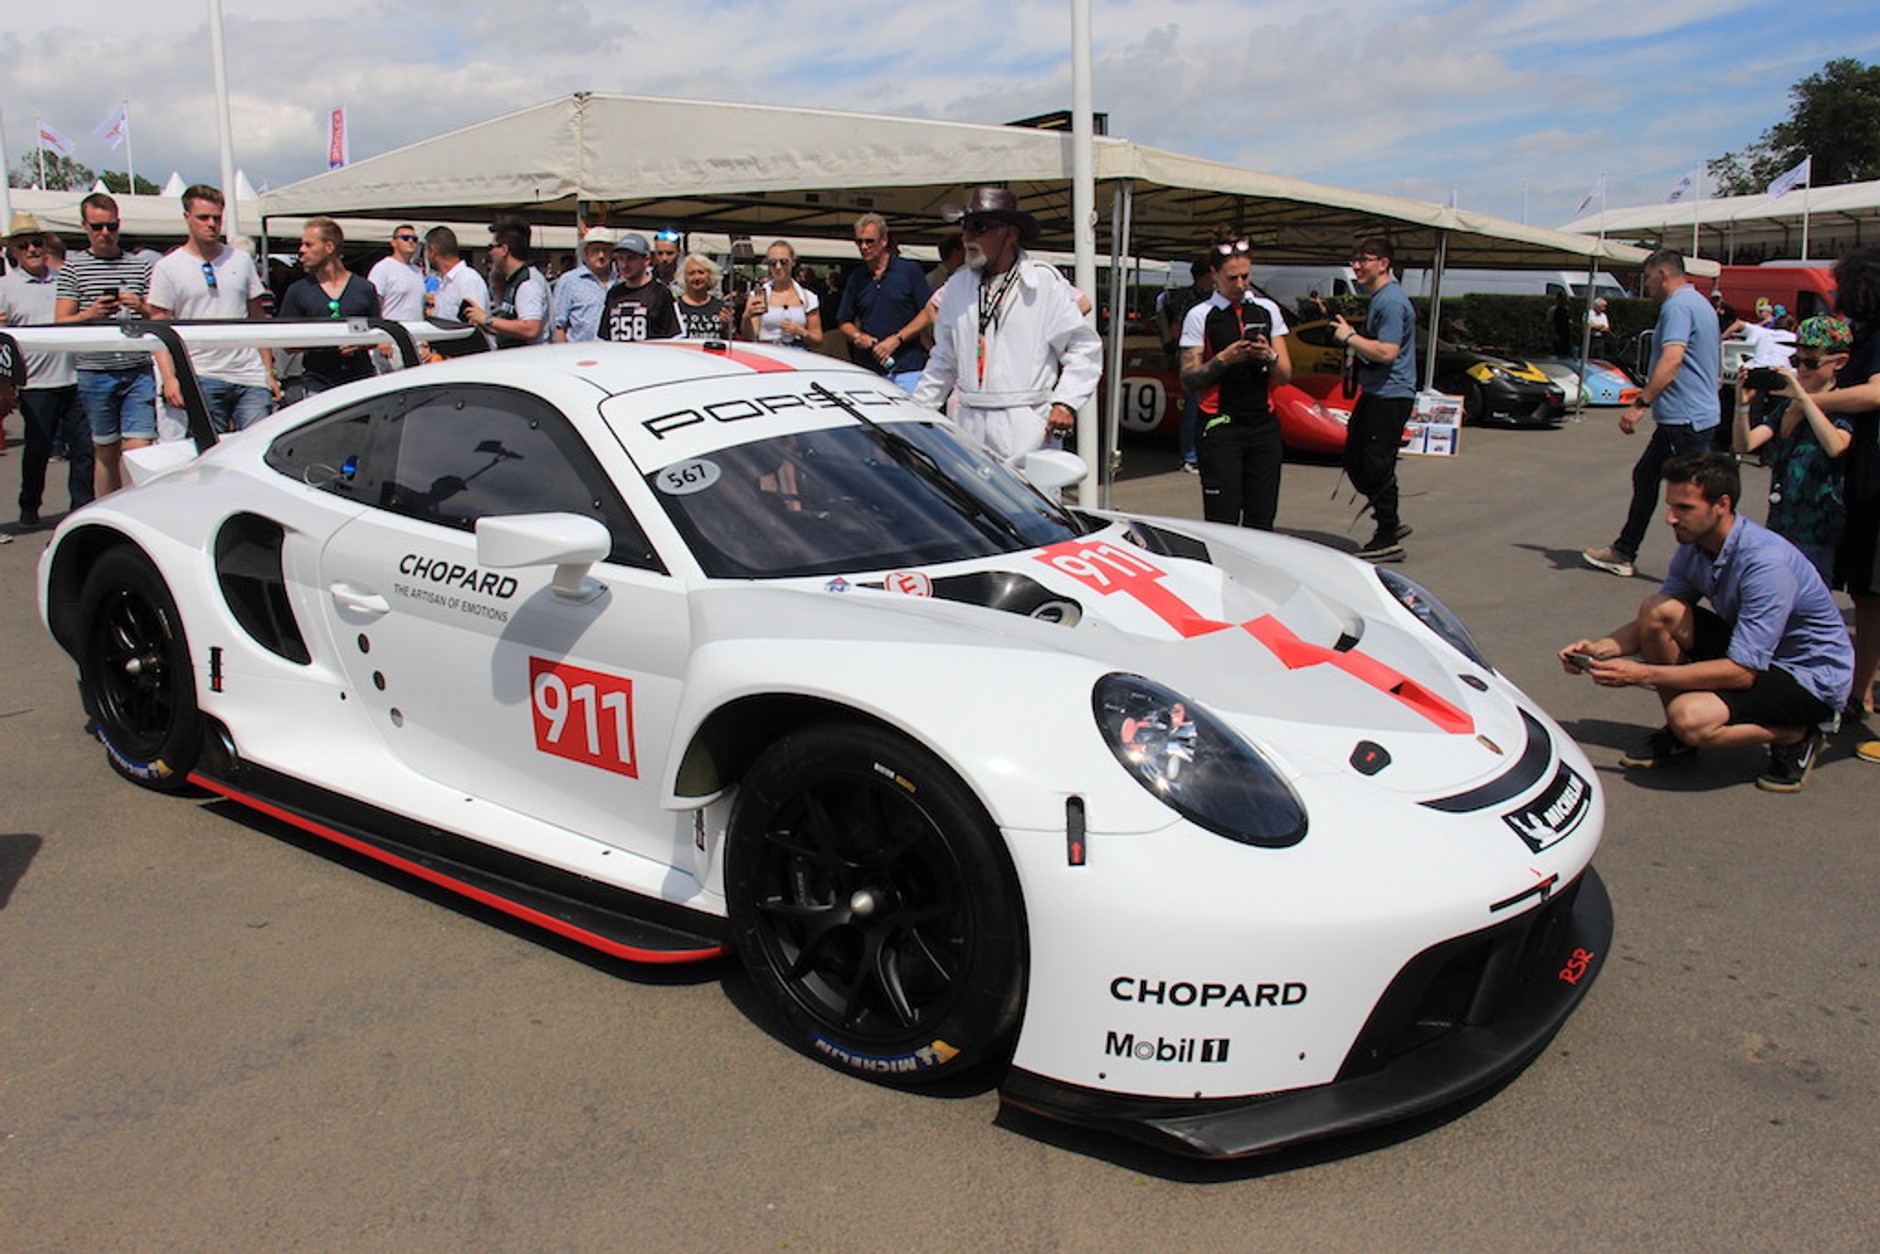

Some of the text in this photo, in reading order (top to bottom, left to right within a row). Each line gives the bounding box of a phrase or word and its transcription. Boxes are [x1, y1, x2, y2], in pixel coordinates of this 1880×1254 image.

[610, 315, 648, 340] 258
[641, 390, 910, 440] PORSCH
[1122, 383, 1157, 423] 19
[666, 464, 708, 489] 567
[399, 554, 519, 600] CHOPARD
[1052, 546, 1156, 588] 911
[394, 583, 509, 624] THE ARTISAN OF EMOTIONS
[533, 671, 632, 765] 911
[1543, 773, 1584, 828] MICHELIN
[1559, 947, 1595, 986] RSR
[1109, 976, 1308, 1008] CHOPARD
[815, 1039, 918, 1073] MICHELIN
[1104, 1030, 1226, 1064] Mobil 1
